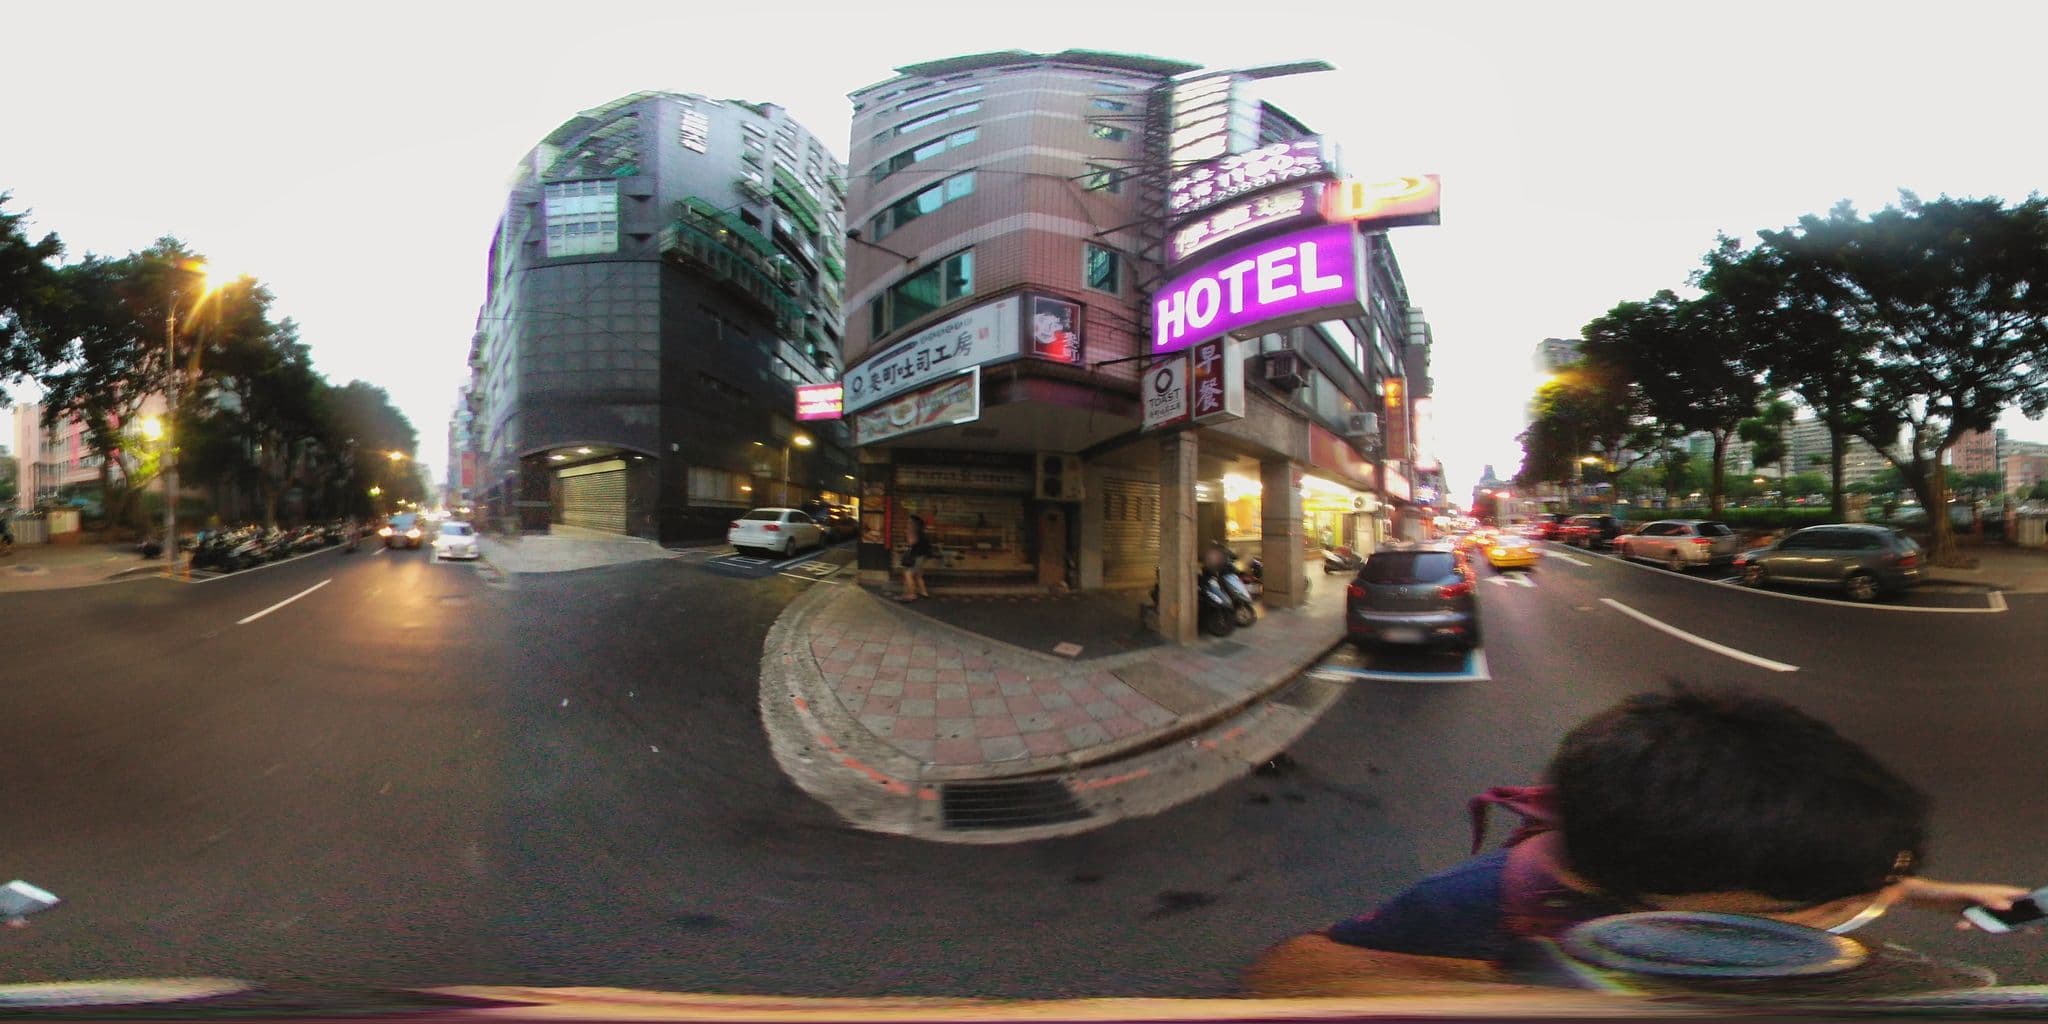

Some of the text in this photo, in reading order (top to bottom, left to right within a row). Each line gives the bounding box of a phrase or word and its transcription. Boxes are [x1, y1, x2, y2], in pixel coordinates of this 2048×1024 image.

[1157, 242, 1342, 345] HOTEL
[1149, 387, 1181, 408] TOAST
[1195, 344, 1223, 412] 早餐
